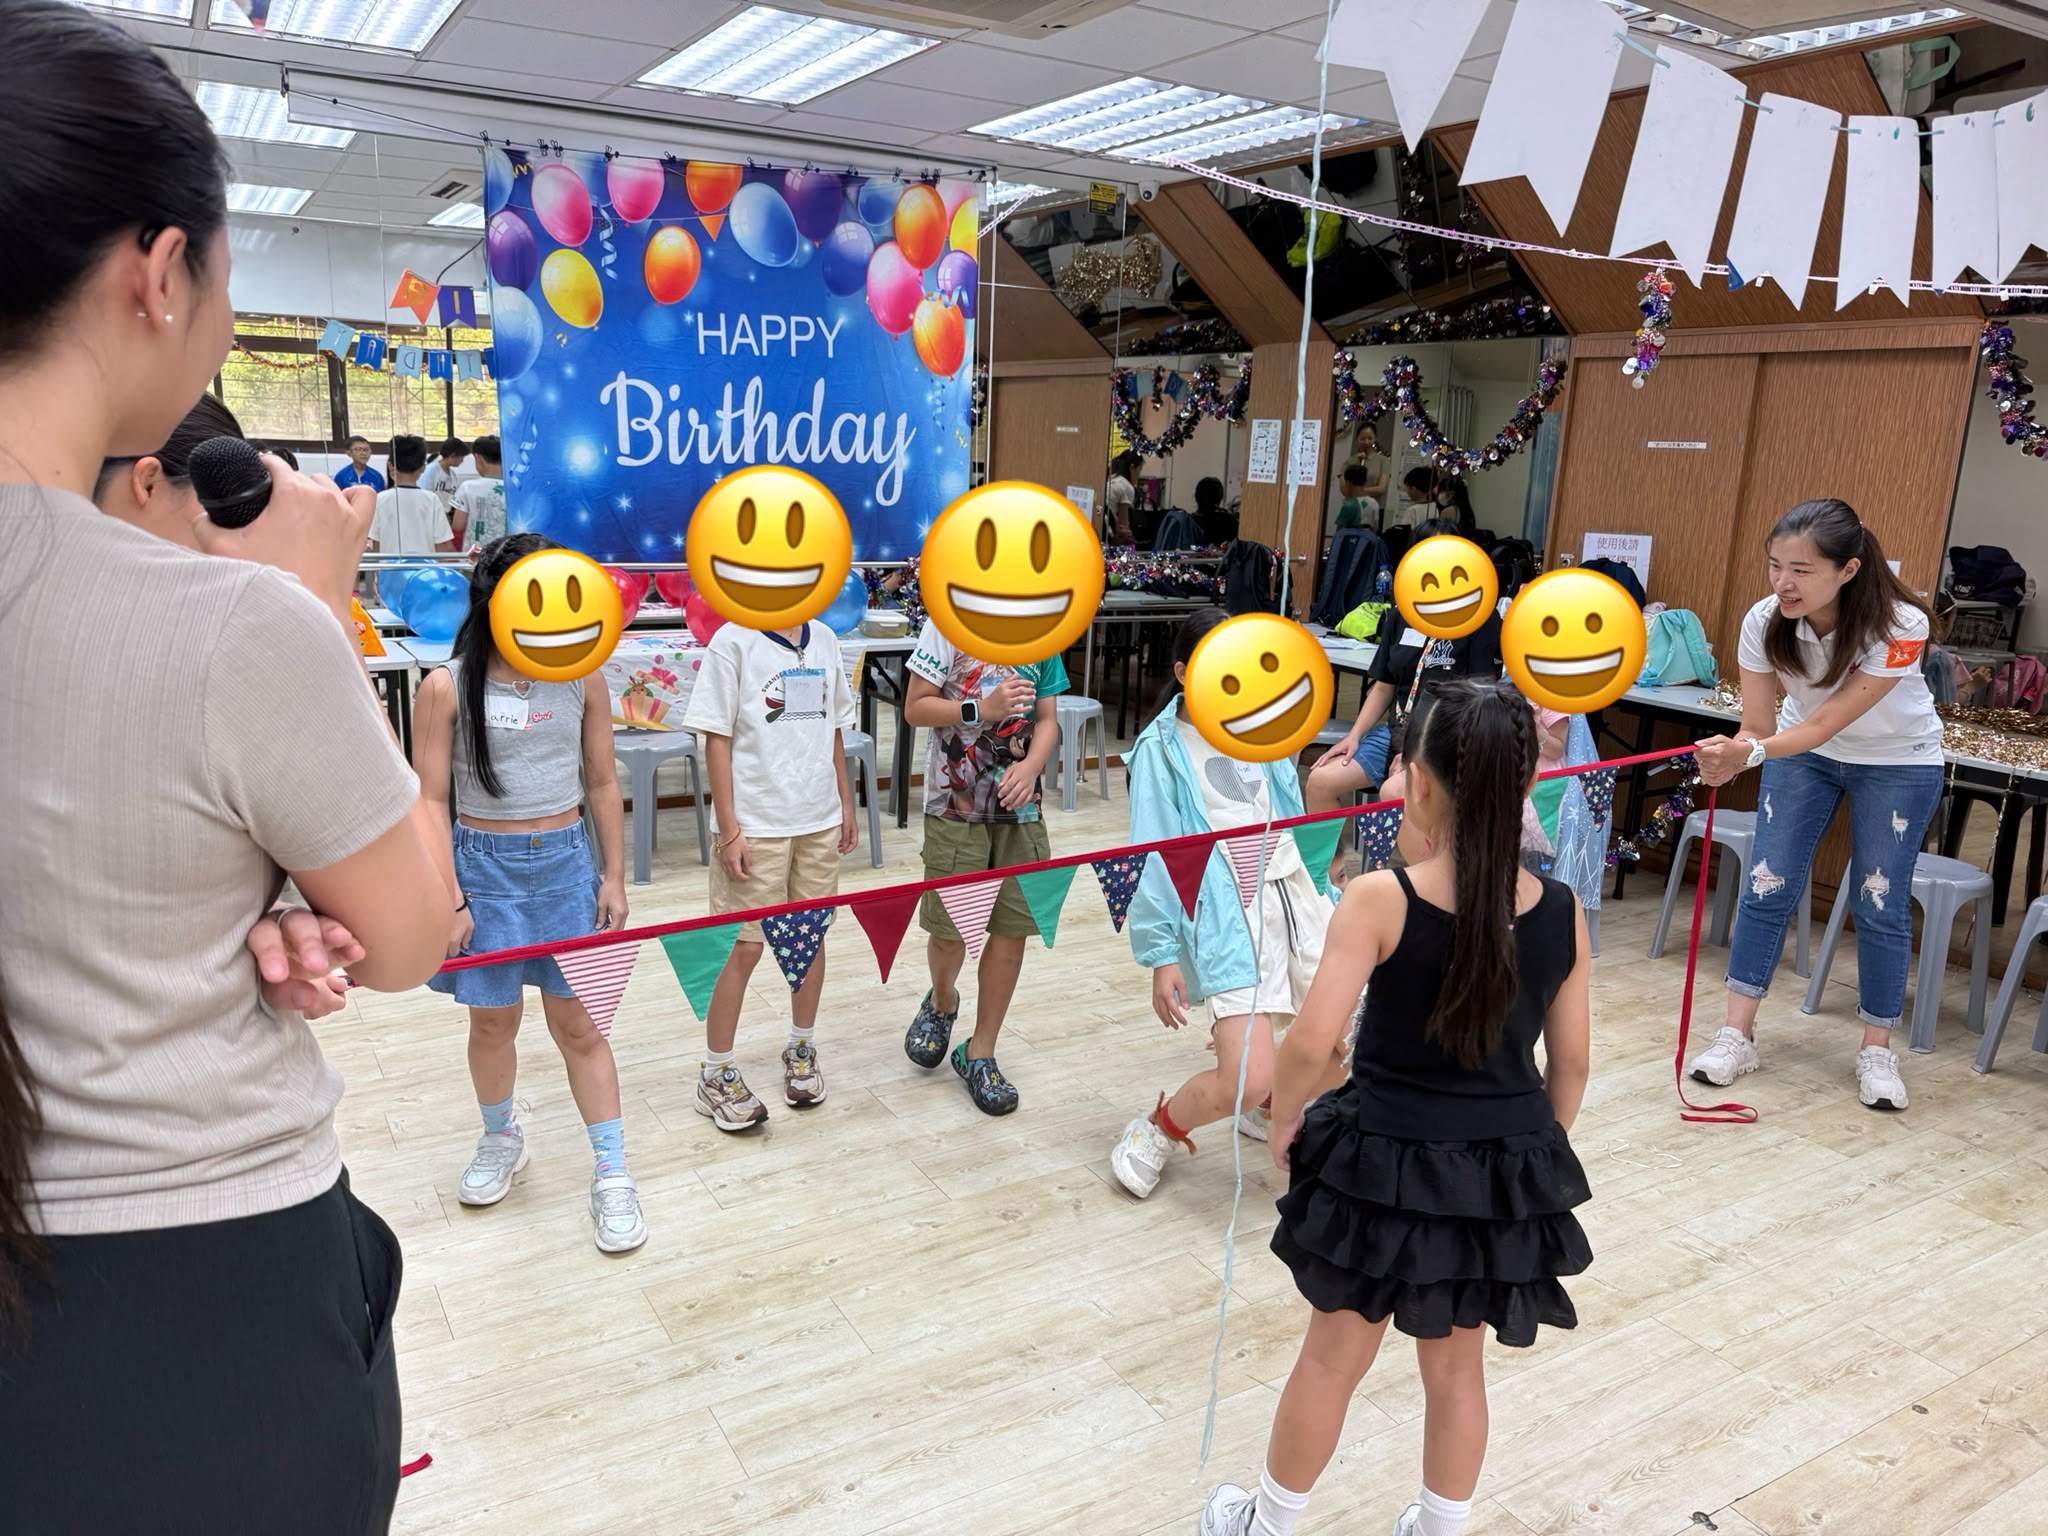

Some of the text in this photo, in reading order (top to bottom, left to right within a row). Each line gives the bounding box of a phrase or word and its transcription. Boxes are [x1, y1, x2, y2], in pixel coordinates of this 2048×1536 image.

[697, 312, 844, 358] HAPPY
[600, 371, 917, 506] Birthday
[1597, 536, 1639, 550] 使用後請
[490, 713, 518, 725] arrie
